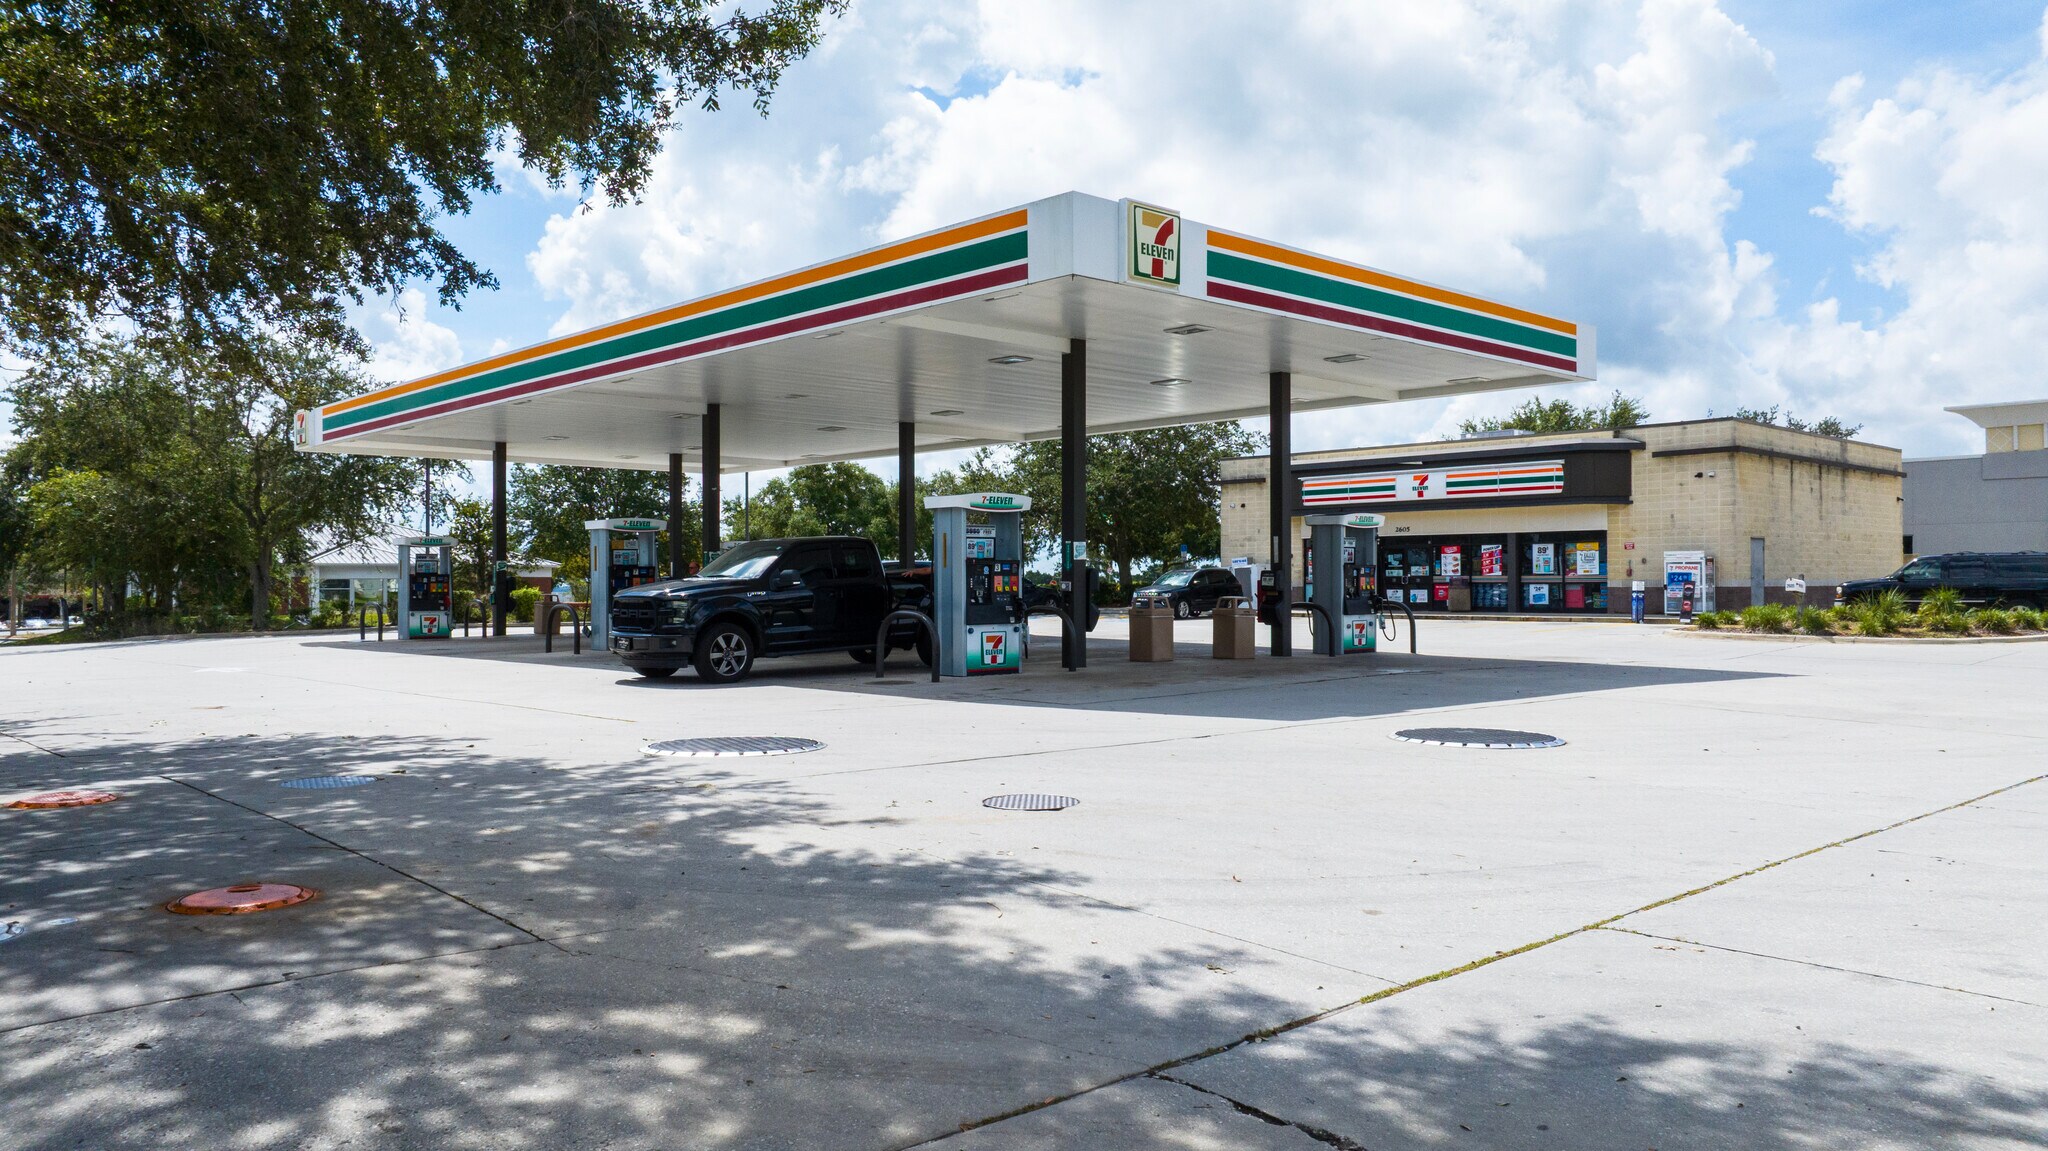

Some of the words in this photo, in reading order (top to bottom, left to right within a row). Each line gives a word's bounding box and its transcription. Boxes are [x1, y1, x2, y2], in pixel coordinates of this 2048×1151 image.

[1142, 210, 1174, 279] 7
[1413, 474, 1429, 498] 7
[1355, 623, 1366, 645] 7
[985, 634, 1003, 664] 7
